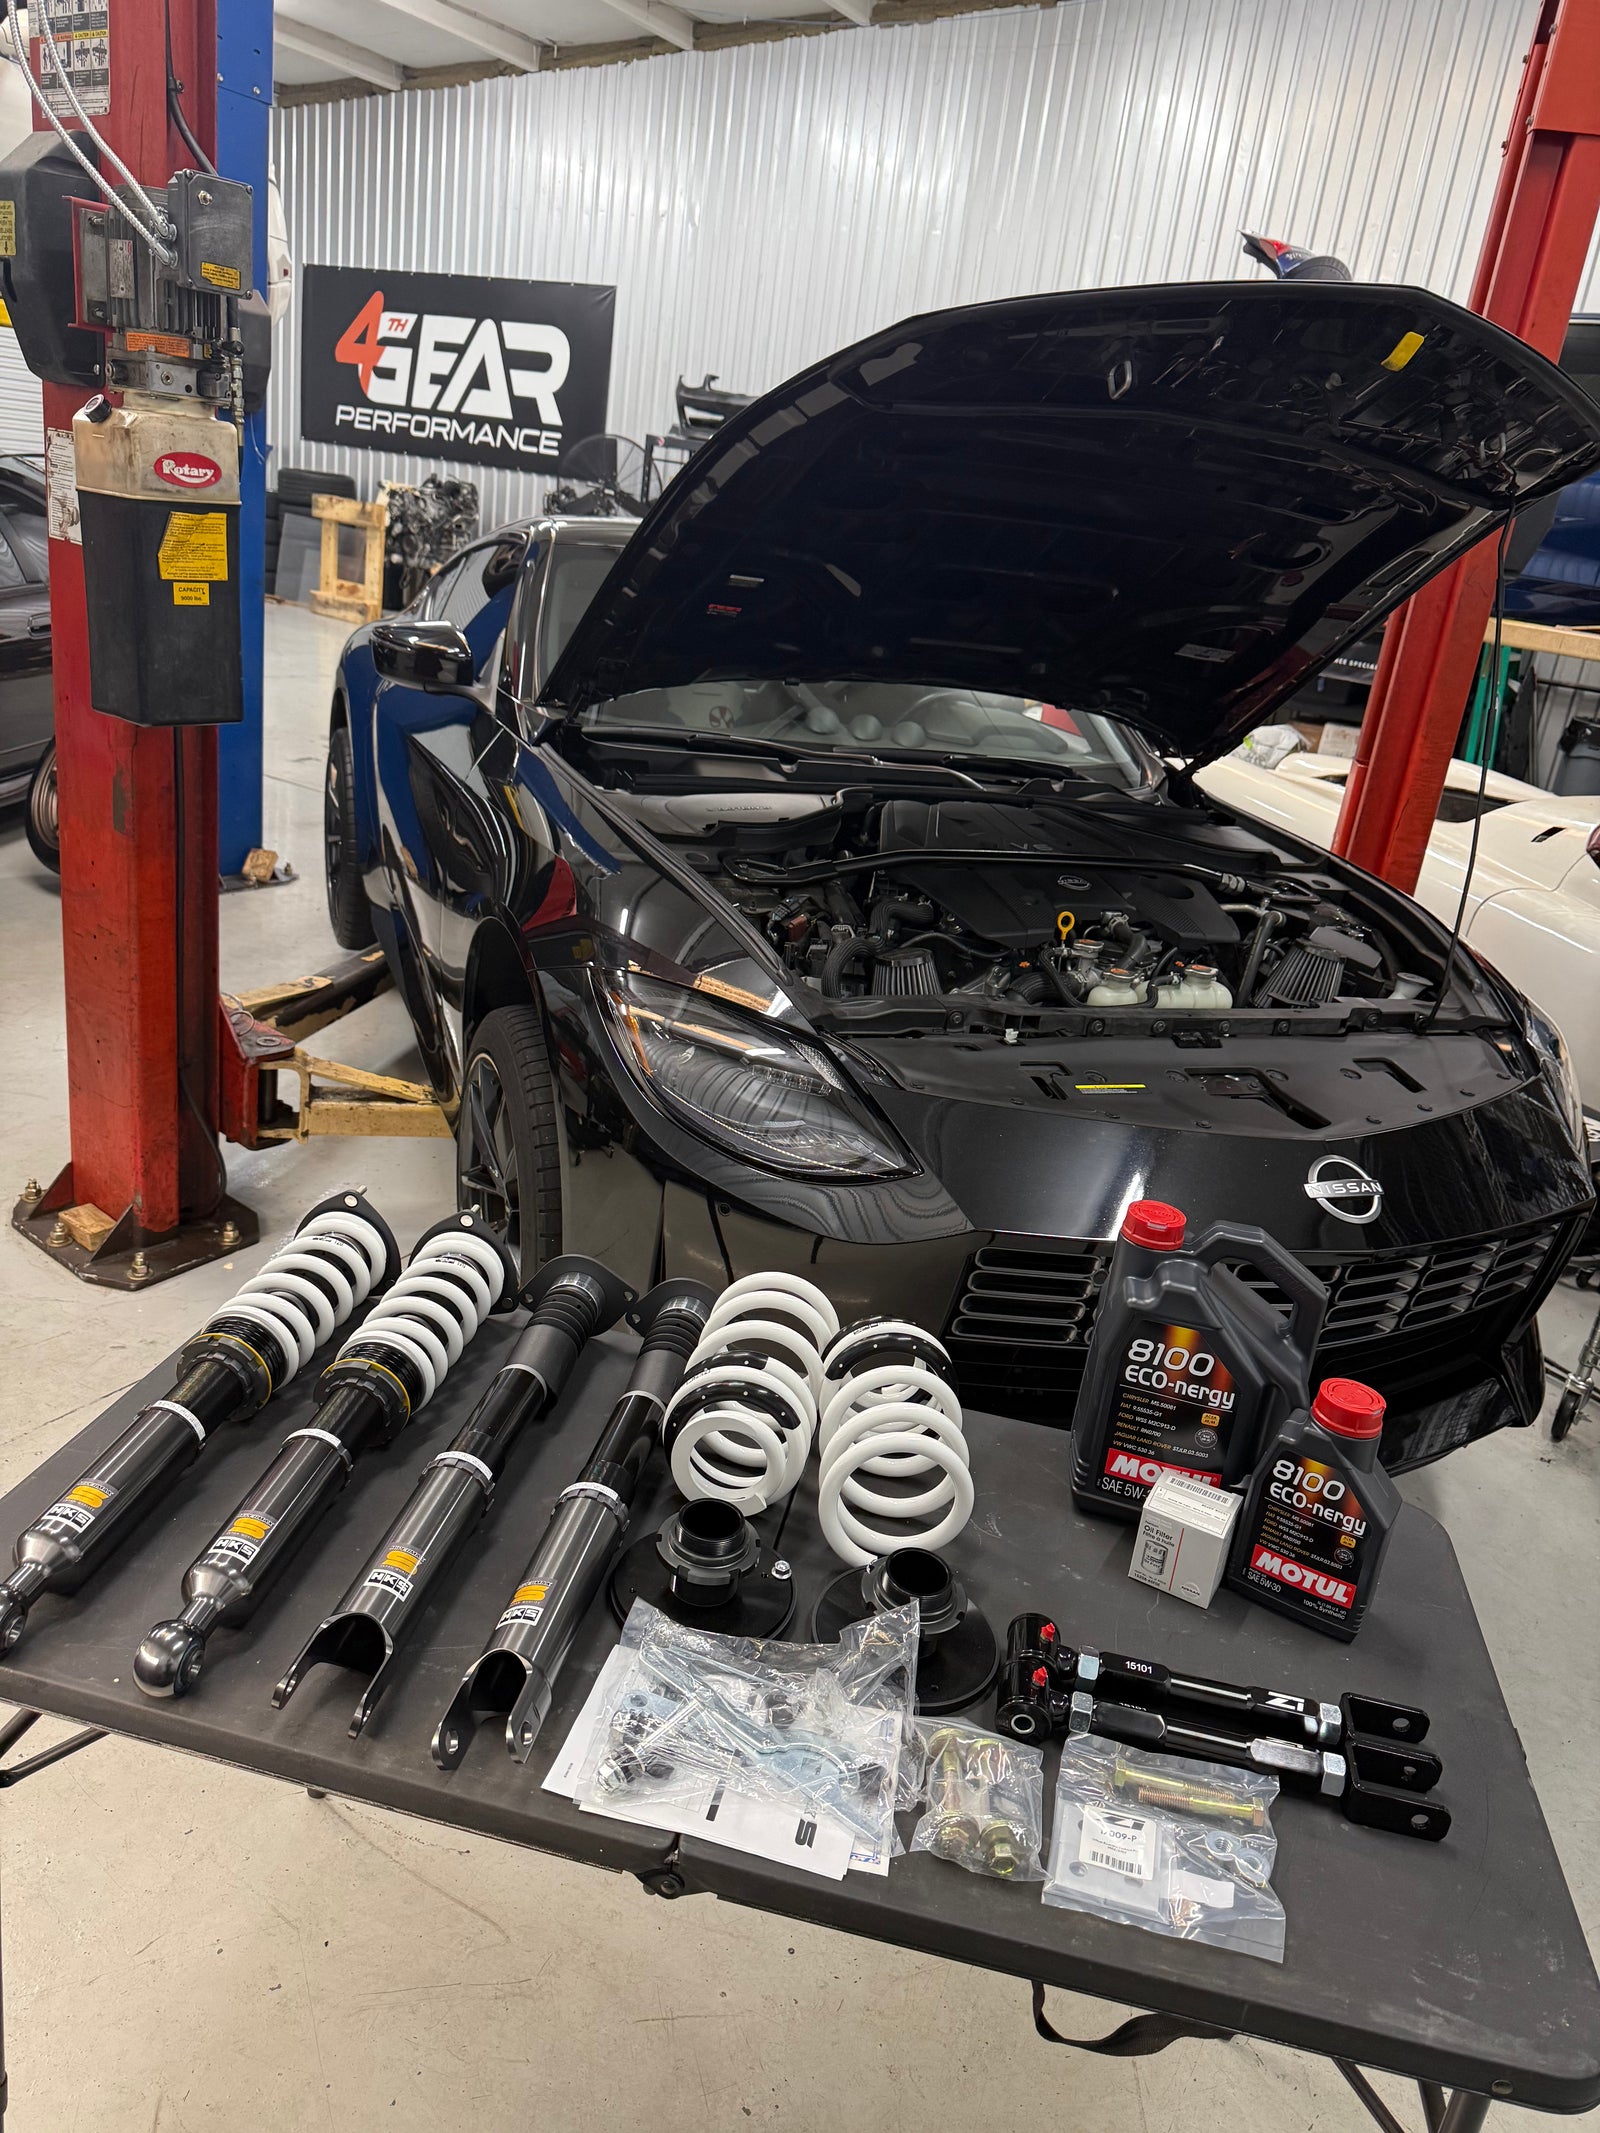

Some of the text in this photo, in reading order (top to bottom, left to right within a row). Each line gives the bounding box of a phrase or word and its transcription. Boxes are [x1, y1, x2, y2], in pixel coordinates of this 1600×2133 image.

[358, 311, 571, 426] GEAR
[335, 404, 562, 456] PERFORMANCE
[162, 459, 214, 482] Rotary
[1307, 1182, 1383, 1195] NISSAN
[1128, 1339, 1215, 1377] 8100
[1120, 1402, 1131, 1410] FIAT
[1122, 1393, 1150, 1403] CHRYSLER
[1116, 1421, 1140, 1431] RENAULT
[1118, 1412, 1134, 1420] FORD
[1136, 1416, 1148, 1424] WSS
[1115, 1432, 1137, 1441] JAGUAR
[1137, 1437, 1153, 1446] LAND
[1153, 1441, 1172, 1451] ROVER
[1102, 1477, 1124, 1494] SAE
[1273, 1460, 1346, 1501] 8100
[45, 1505, 92, 1529] HKS
[1264, 1518, 1278, 1527] FORD
[1144, 1525, 1174, 1541] Oil Filter
[211, 1538, 257, 1561] HKS
[1280, 1540, 1294, 1549] LAND
[1294, 1546, 1310, 1556] ROVER
[367, 1571, 411, 1597] HKS
[1248, 1572, 1282, 1593] SAE 5W-30
[1256, 1552, 1349, 1603] MOTUL
[499, 1607, 540, 1625] HKS
[1304, 1599, 1346, 1620] 100% Synthetic
[1125, 1660, 1153, 1674] 15101
